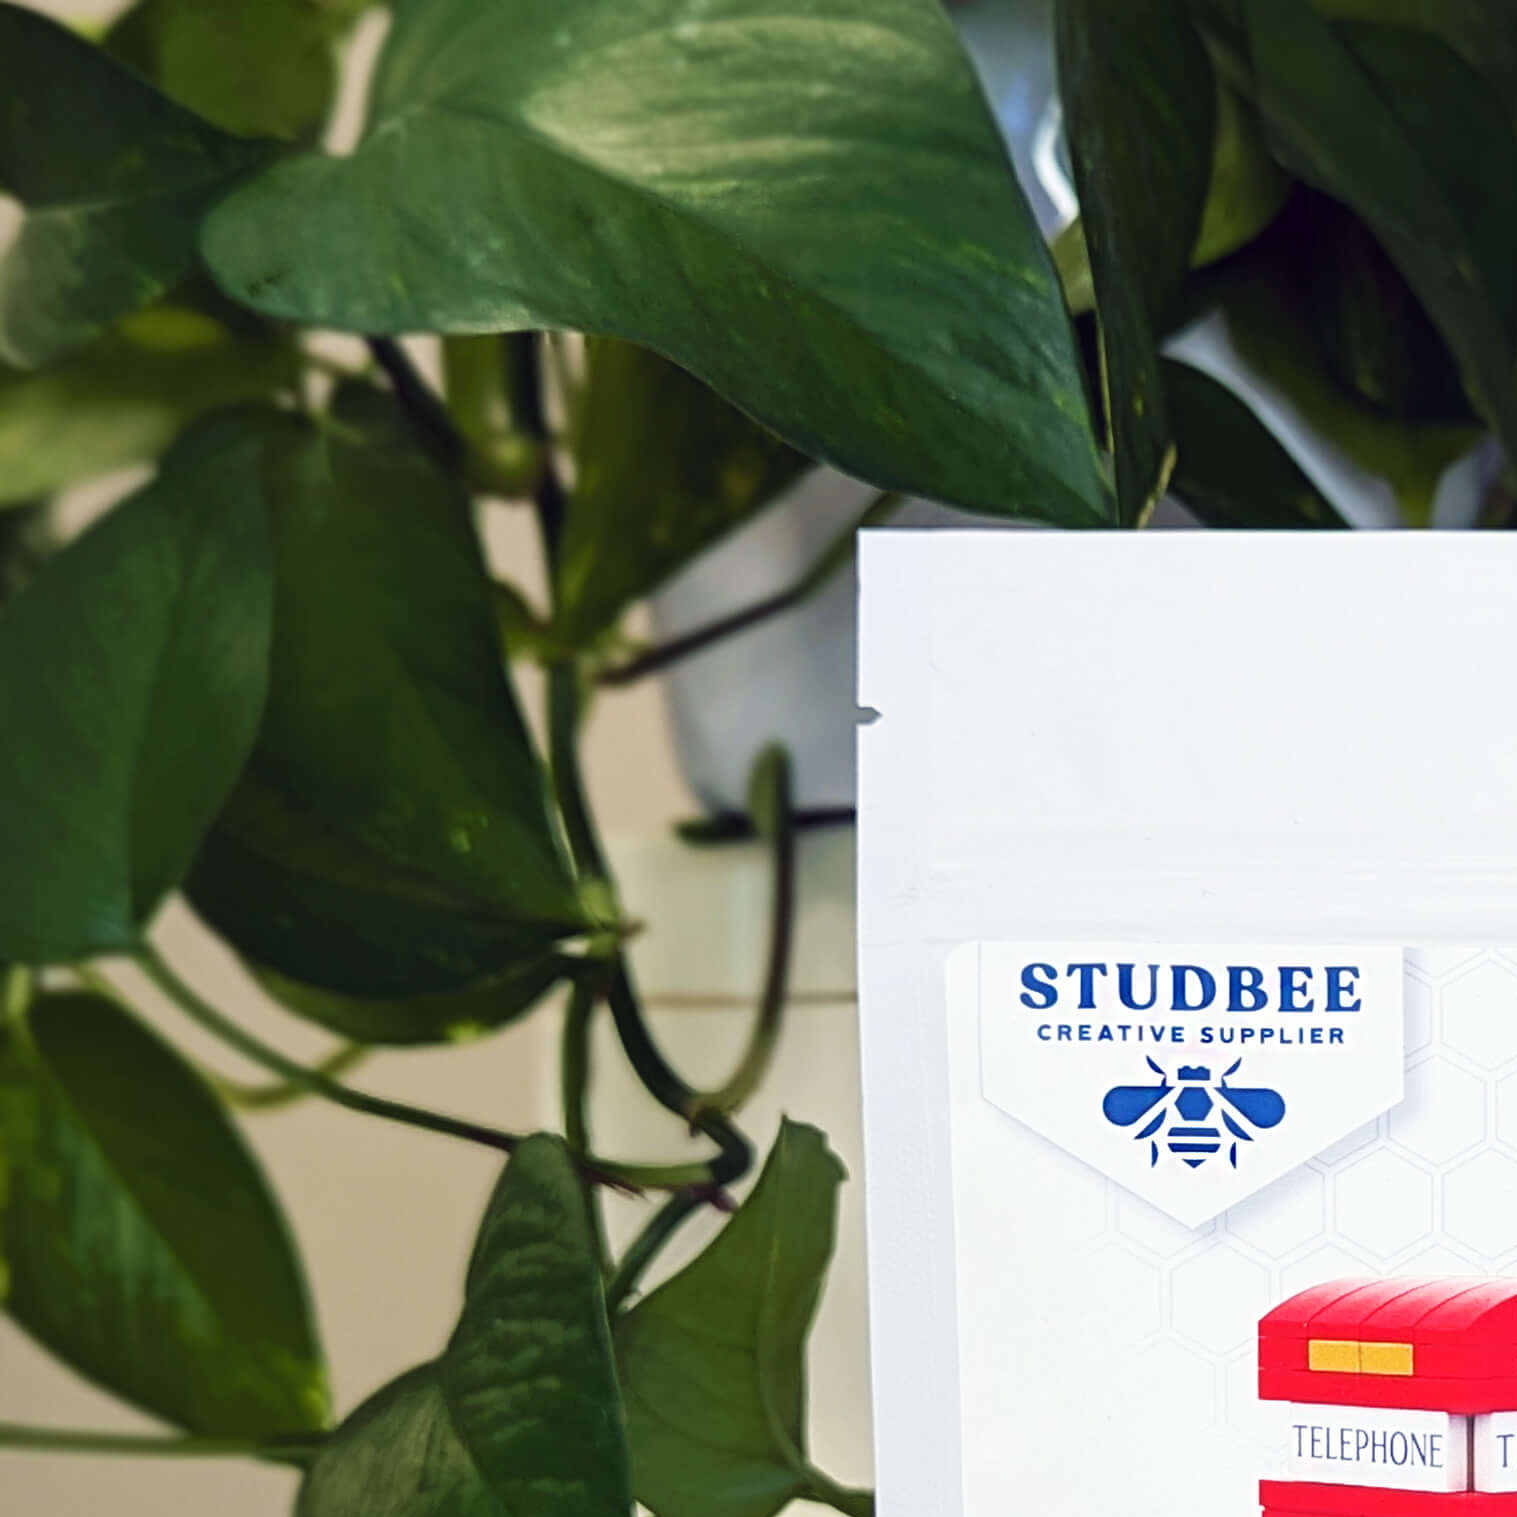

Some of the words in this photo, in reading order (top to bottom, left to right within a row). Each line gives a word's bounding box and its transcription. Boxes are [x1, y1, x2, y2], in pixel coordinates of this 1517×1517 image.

[1018, 962, 1363, 1014] STUDBEE
[1036, 1023, 1185, 1044] CREATIVE
[1199, 1025, 1345, 1045] SUPPLIER
[1292, 1424, 1443, 1469] TELEPHONE
